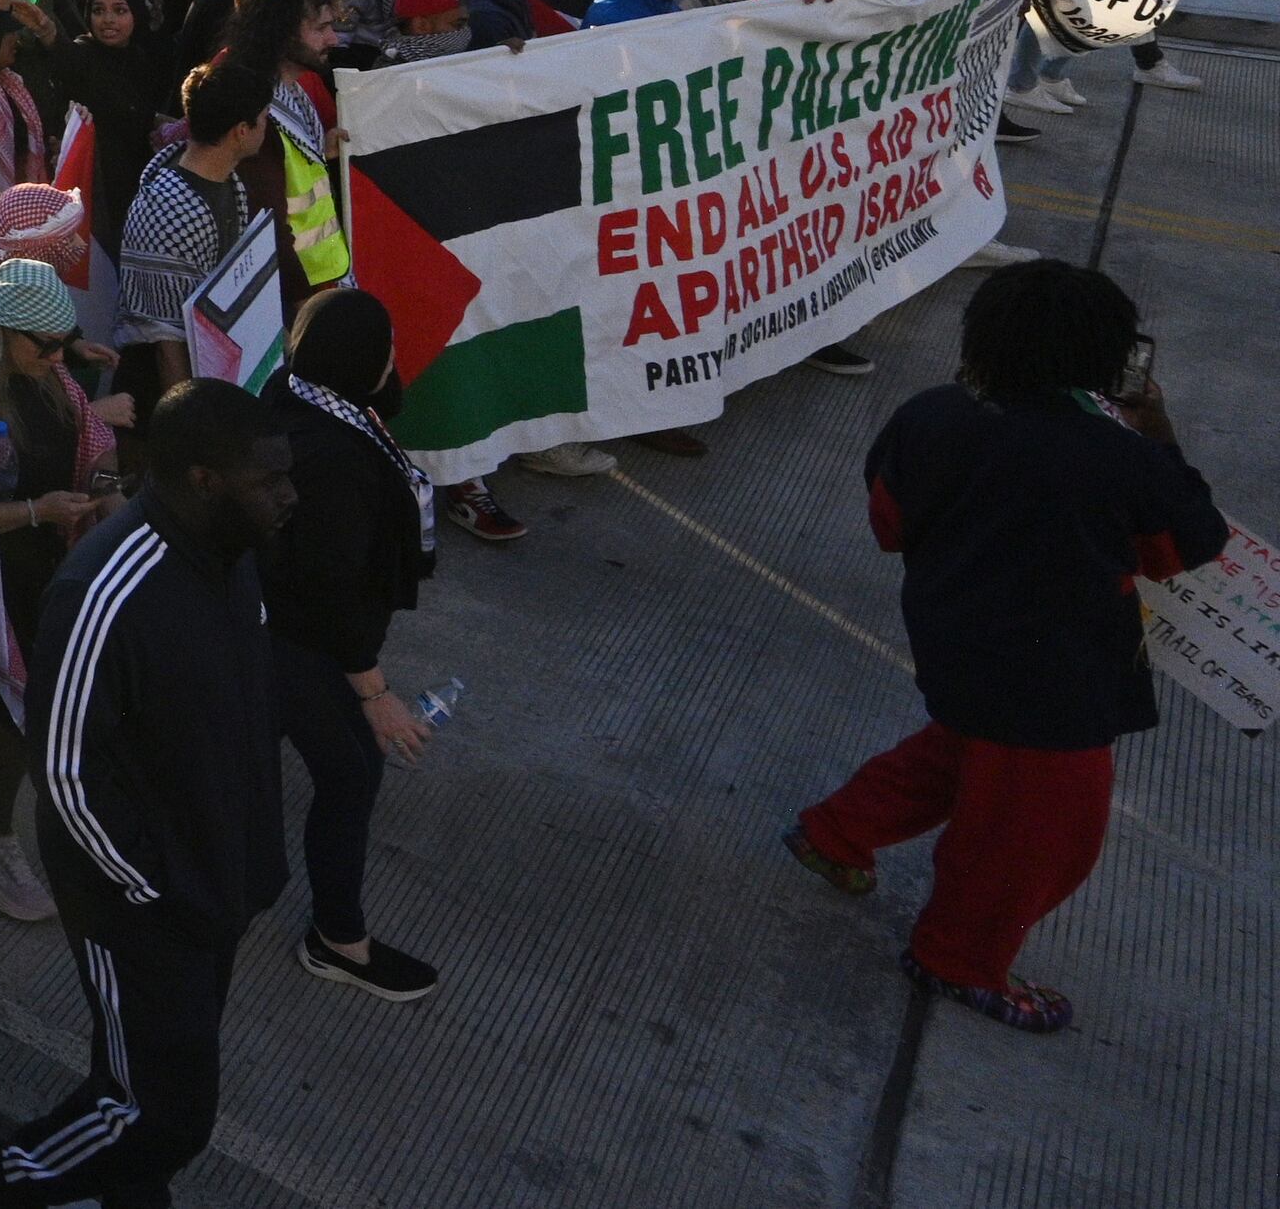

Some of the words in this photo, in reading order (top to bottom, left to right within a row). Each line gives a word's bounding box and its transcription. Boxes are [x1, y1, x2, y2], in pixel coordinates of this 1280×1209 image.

[591, 57, 745, 205] FREE
[598, 192, 726, 276] END
[737, 157, 789, 238] ALL
[800, 132, 860, 199] U.S.
[867, 107, 917, 174] AID
[922, 87, 951, 143] TO
[622, 203, 845, 347] APARTHEID
[854, 150, 941, 243] ISRAEL
[646, 349, 723, 391] PARTY
[740, 296, 807, 354] SOCIALISM
[821, 255, 867, 311] LIBERATION
[1147, 615, 1201, 665] TRAIL
[1201, 659, 1227, 679] OF
[1225, 676, 1273, 720] TEARS
